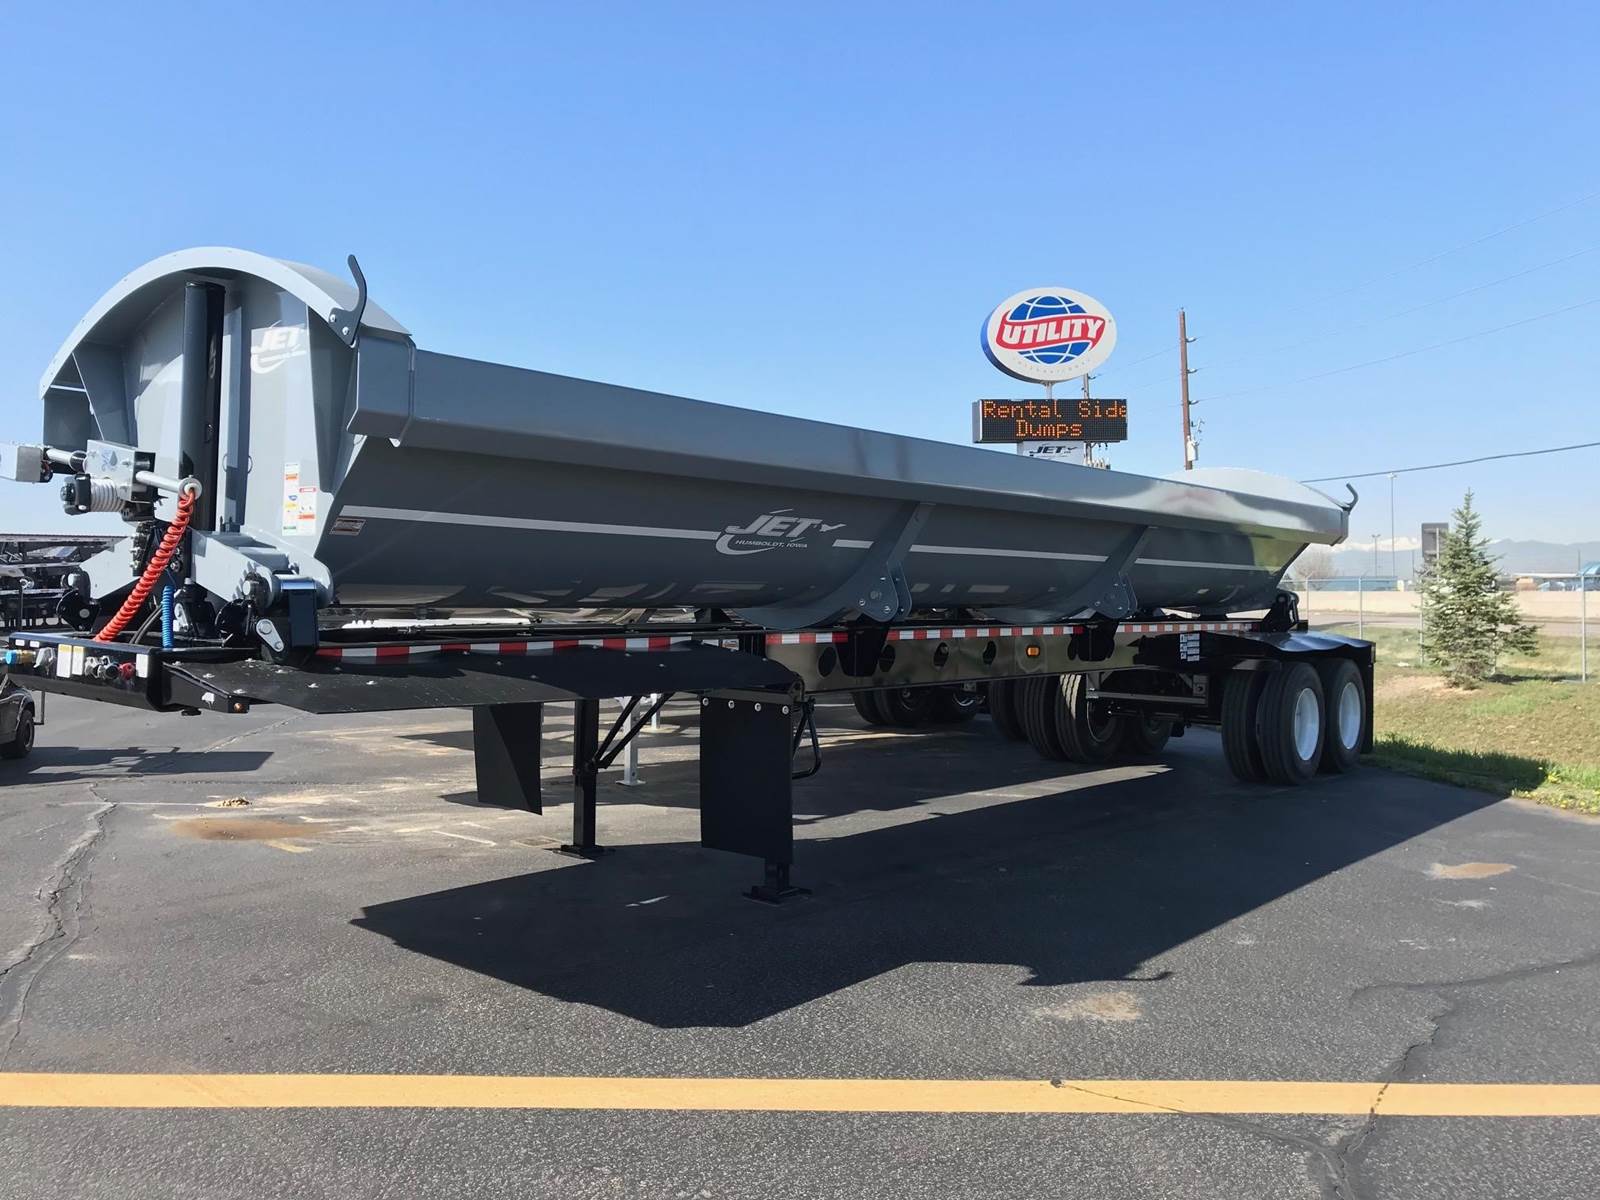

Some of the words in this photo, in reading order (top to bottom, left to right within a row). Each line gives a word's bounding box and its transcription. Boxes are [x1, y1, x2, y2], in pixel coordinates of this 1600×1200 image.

[1003, 318, 1104, 345] UTILITY
[984, 400, 1062, 418] Rental
[1016, 419, 1082, 438] Dumps
[1029, 445, 1066, 454] JET
[724, 514, 822, 537] JET
[735, 539, 785, 548] HUMBOLDT,
